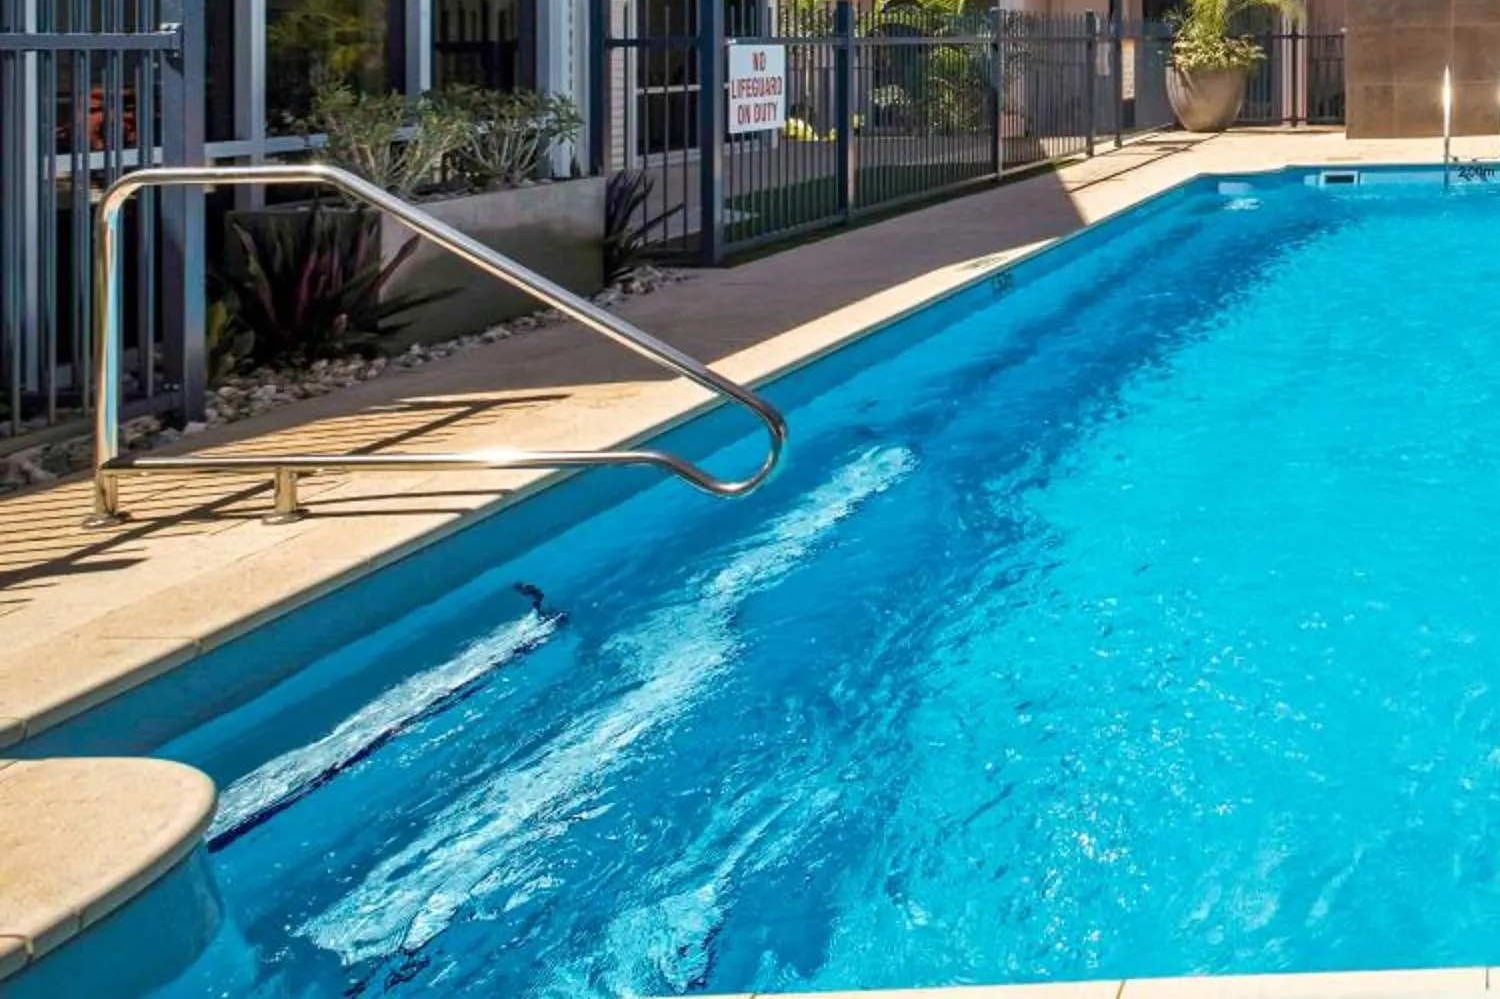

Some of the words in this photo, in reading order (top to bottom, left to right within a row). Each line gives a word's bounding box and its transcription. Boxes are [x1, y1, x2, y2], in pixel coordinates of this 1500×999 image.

[752, 51, 766, 71] NO
[731, 75, 783, 99] LIFEGUARD
[737, 104, 751, 126] ON
[754, 101, 777, 123] DUTY
